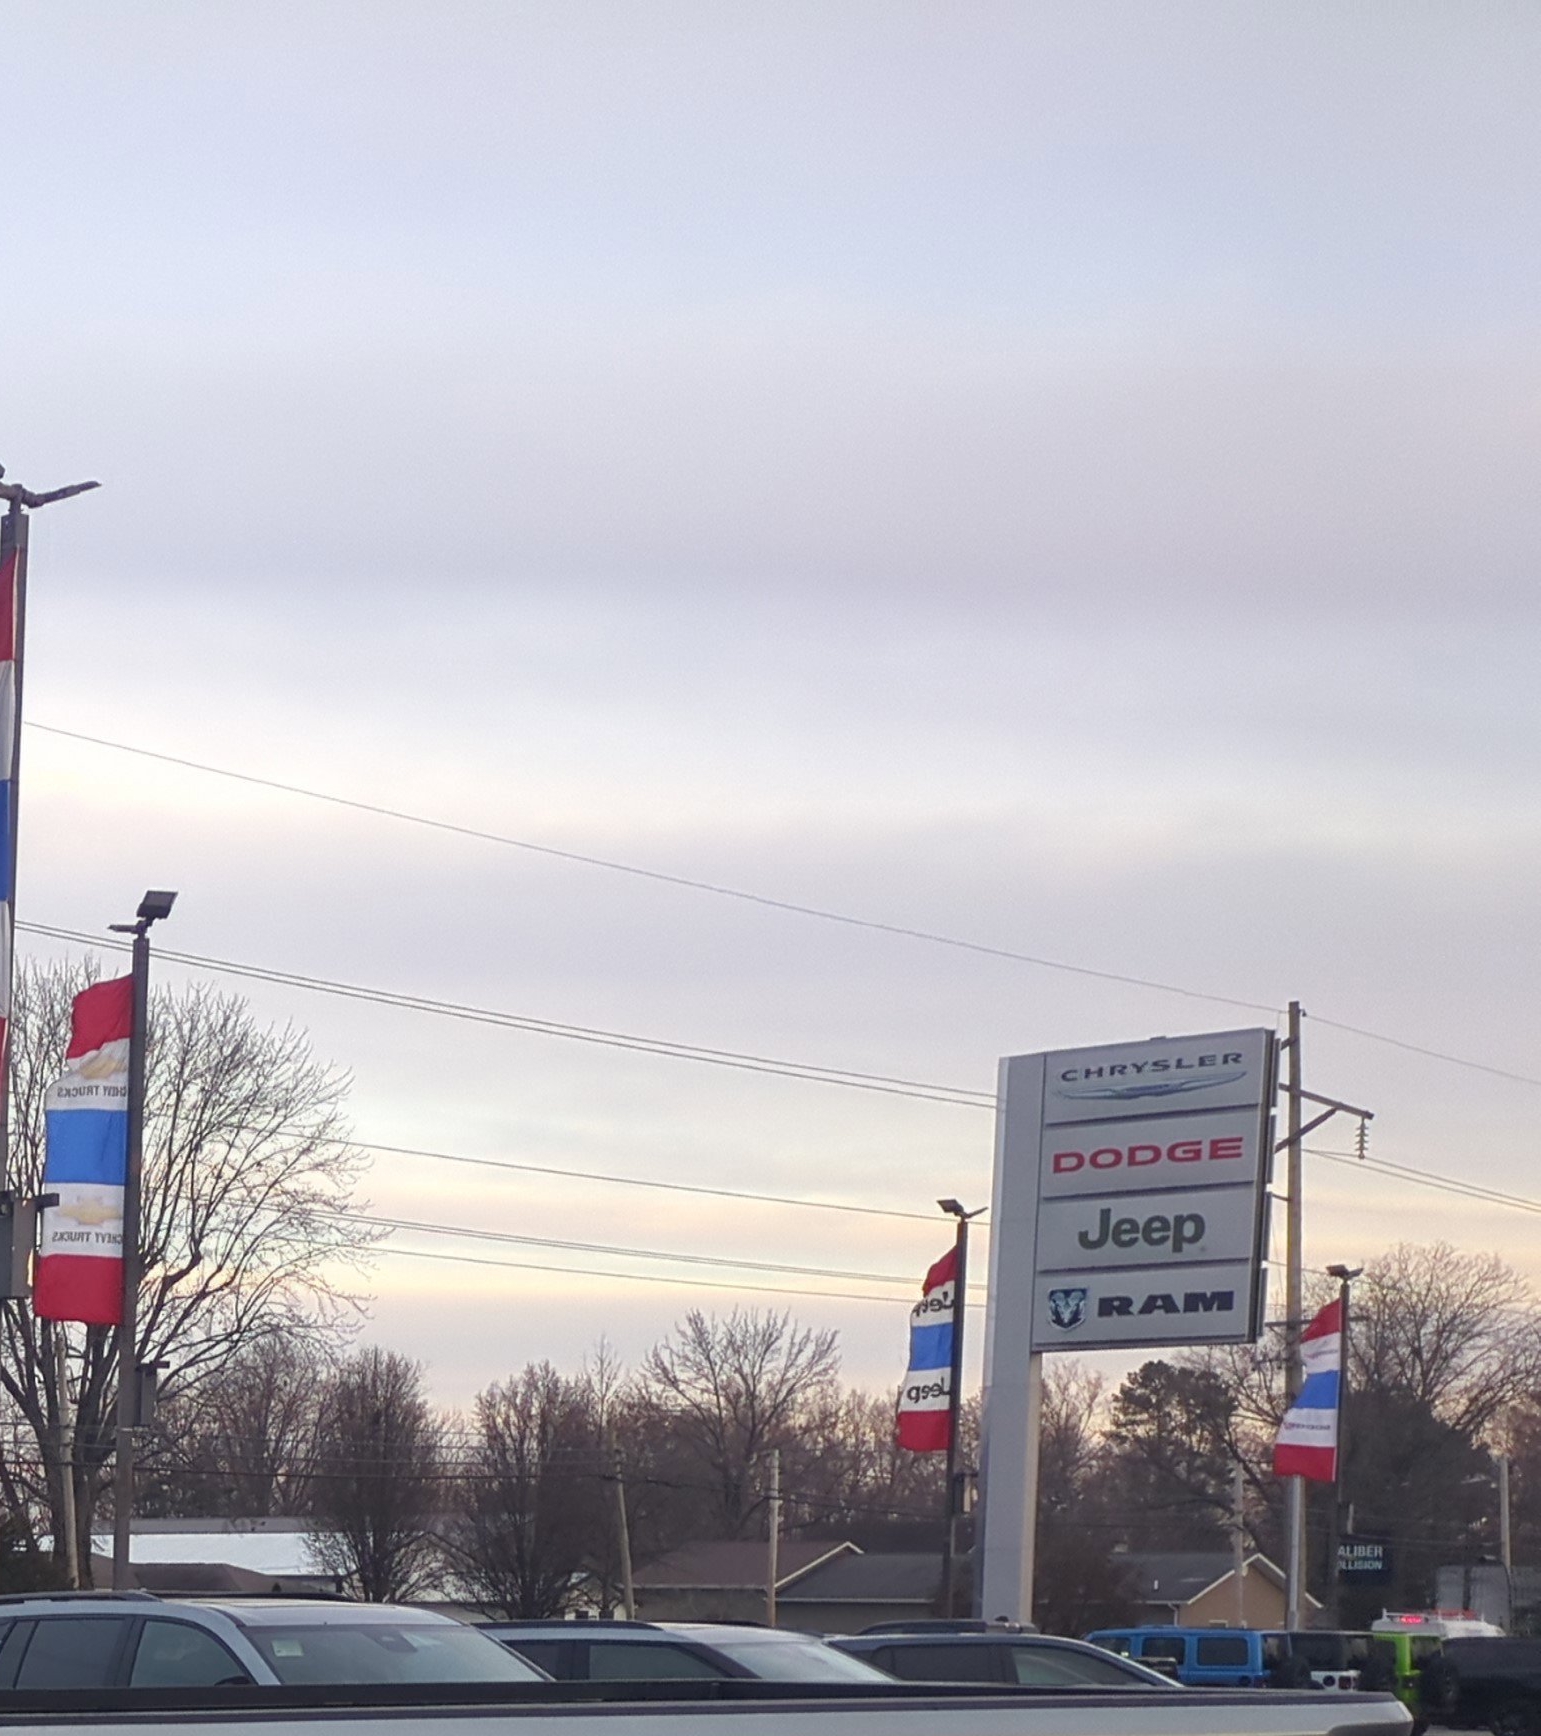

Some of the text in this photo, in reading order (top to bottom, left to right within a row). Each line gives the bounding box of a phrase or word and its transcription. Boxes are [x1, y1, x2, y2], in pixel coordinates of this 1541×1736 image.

[1061, 1052, 1243, 1082] CHRYSLER
[1052, 1136, 1244, 1174] DODGE
[1077, 1207, 1206, 1254] Jeep
[1097, 1290, 1235, 1318] RAM
[1337, 1544, 1383, 1558] ALIBER
